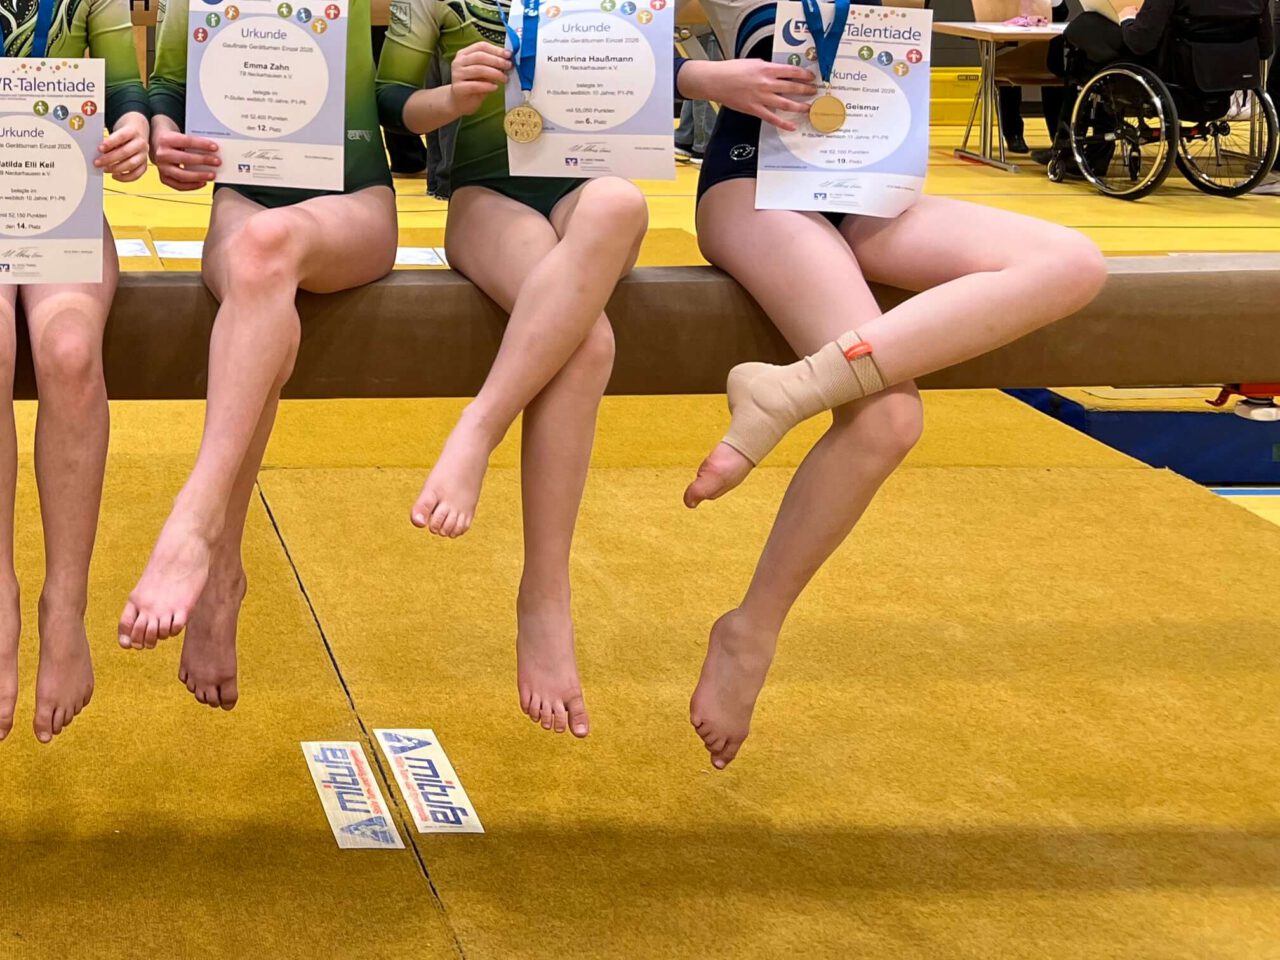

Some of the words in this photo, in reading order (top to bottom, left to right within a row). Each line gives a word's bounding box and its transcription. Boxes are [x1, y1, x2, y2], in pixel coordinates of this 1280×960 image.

[241, 28, 287, 39] Urkunde
[562, 23, 611, 33] Urkunde
[824, 23, 921, 40] Talentiade
[244, 61, 267, 69] Emma
[314, 747, 370, 813] mitufa
[405, 757, 469, 825] mitufa
